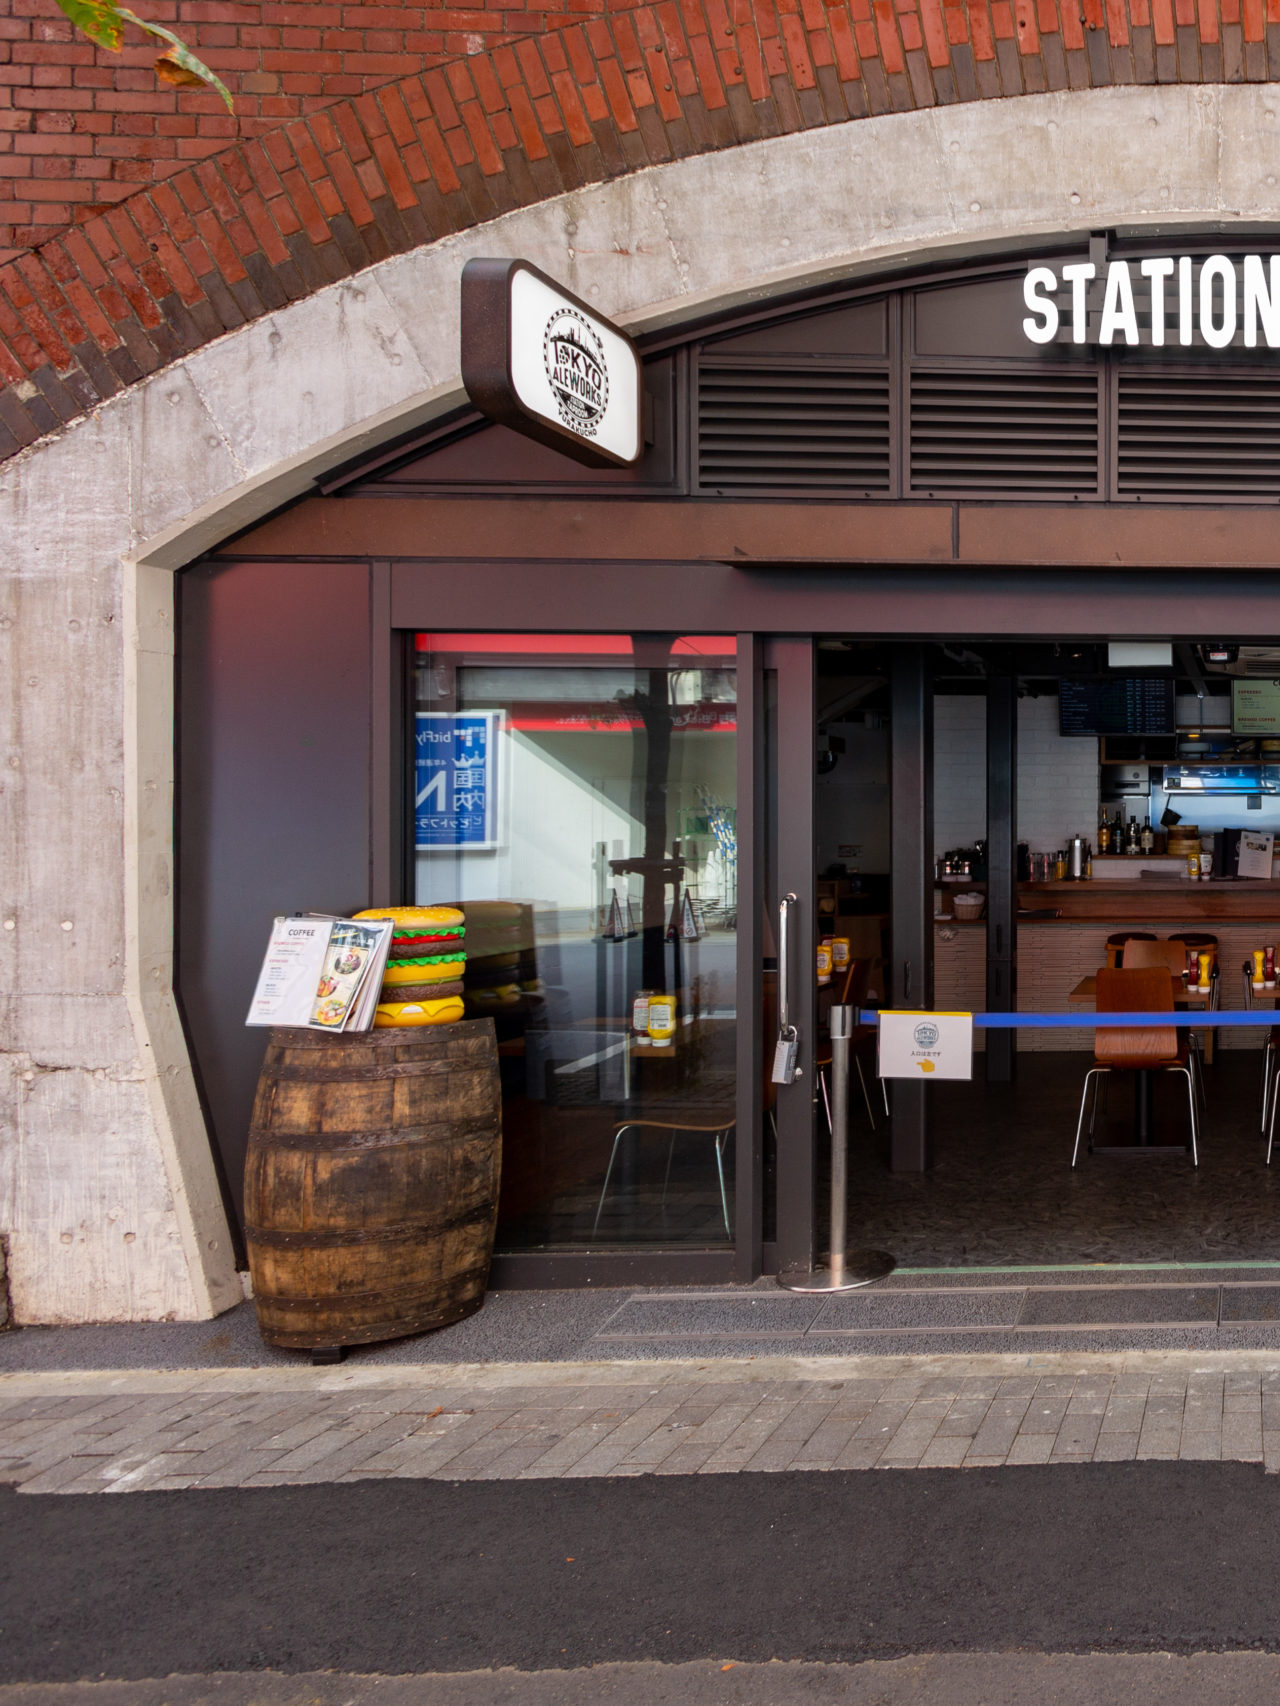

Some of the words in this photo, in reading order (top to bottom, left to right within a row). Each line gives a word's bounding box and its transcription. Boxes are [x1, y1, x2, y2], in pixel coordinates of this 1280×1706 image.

[551, 340, 604, 391] TOKYO
[553, 366, 602, 407] ALEWORKS
[558, 408, 598, 437] YURAKUCHO
